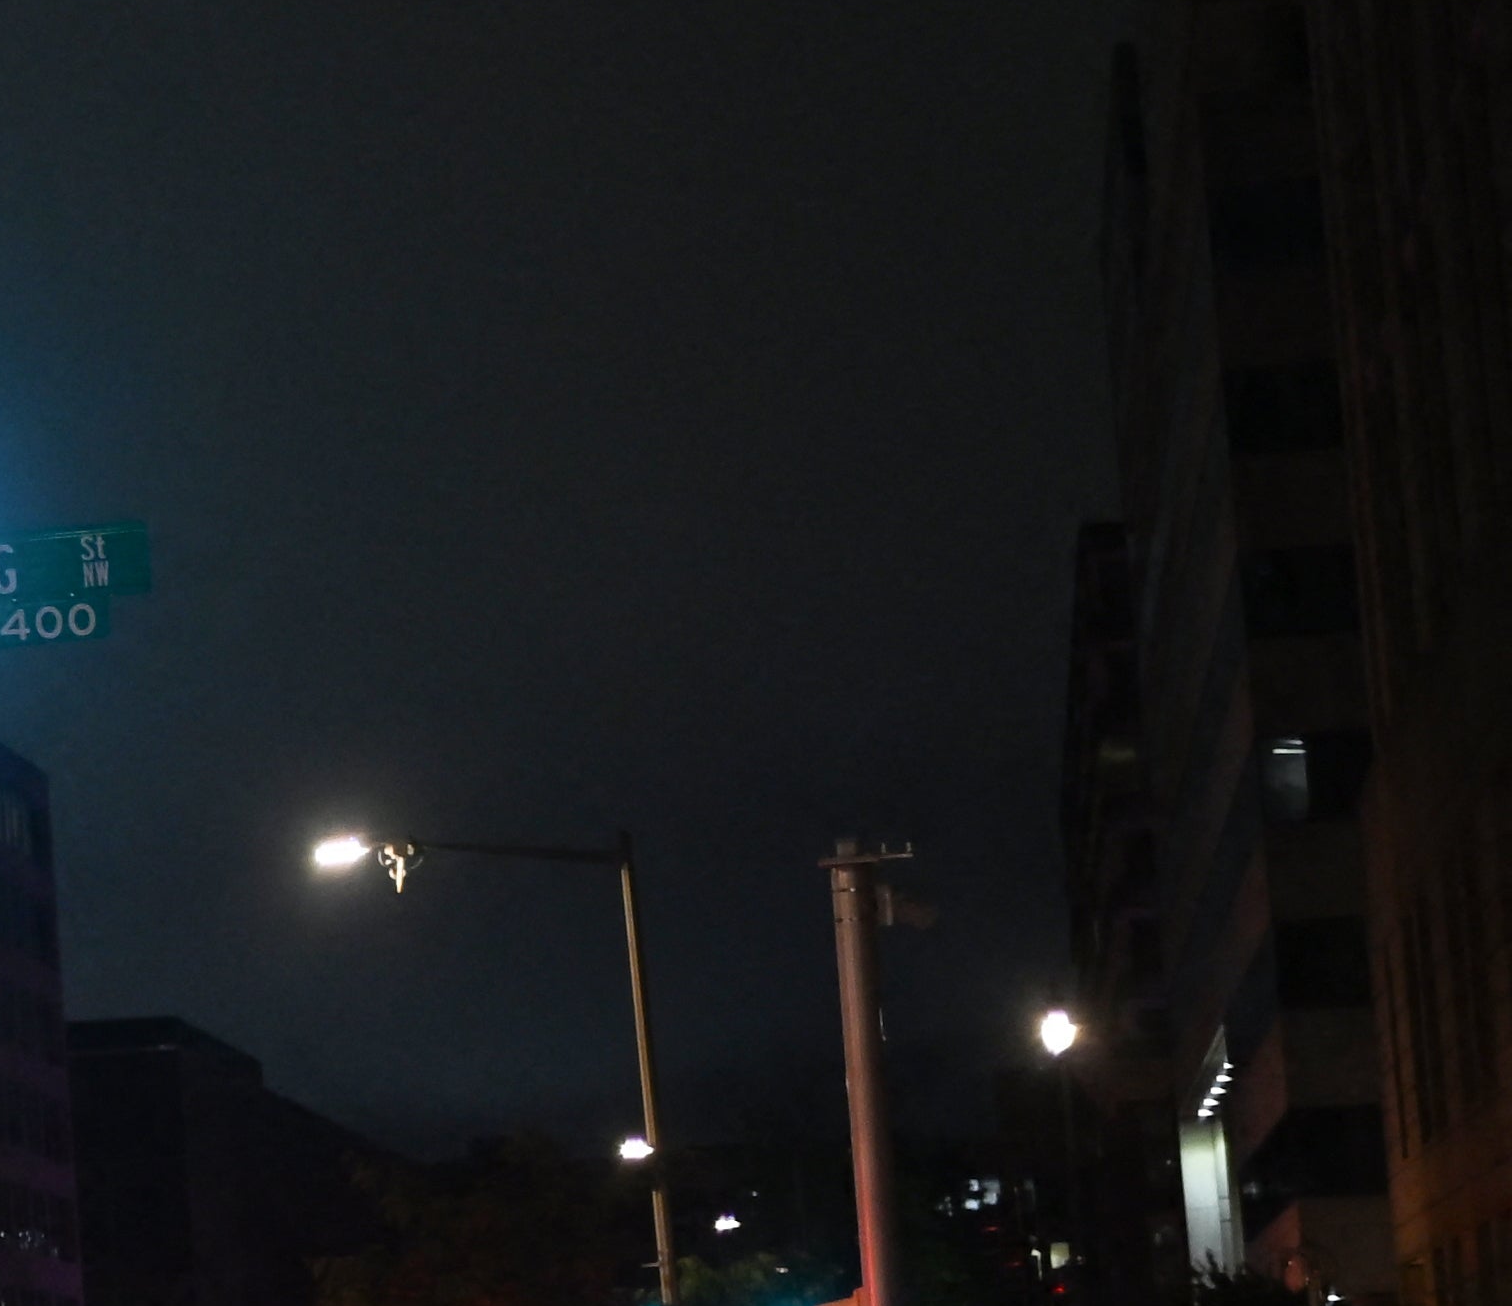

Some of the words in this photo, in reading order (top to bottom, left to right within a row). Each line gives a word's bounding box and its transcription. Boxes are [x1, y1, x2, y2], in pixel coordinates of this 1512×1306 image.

[80, 534, 107, 561] St
[83, 560, 110, 588] NW
[0, 603, 97, 641] 400
